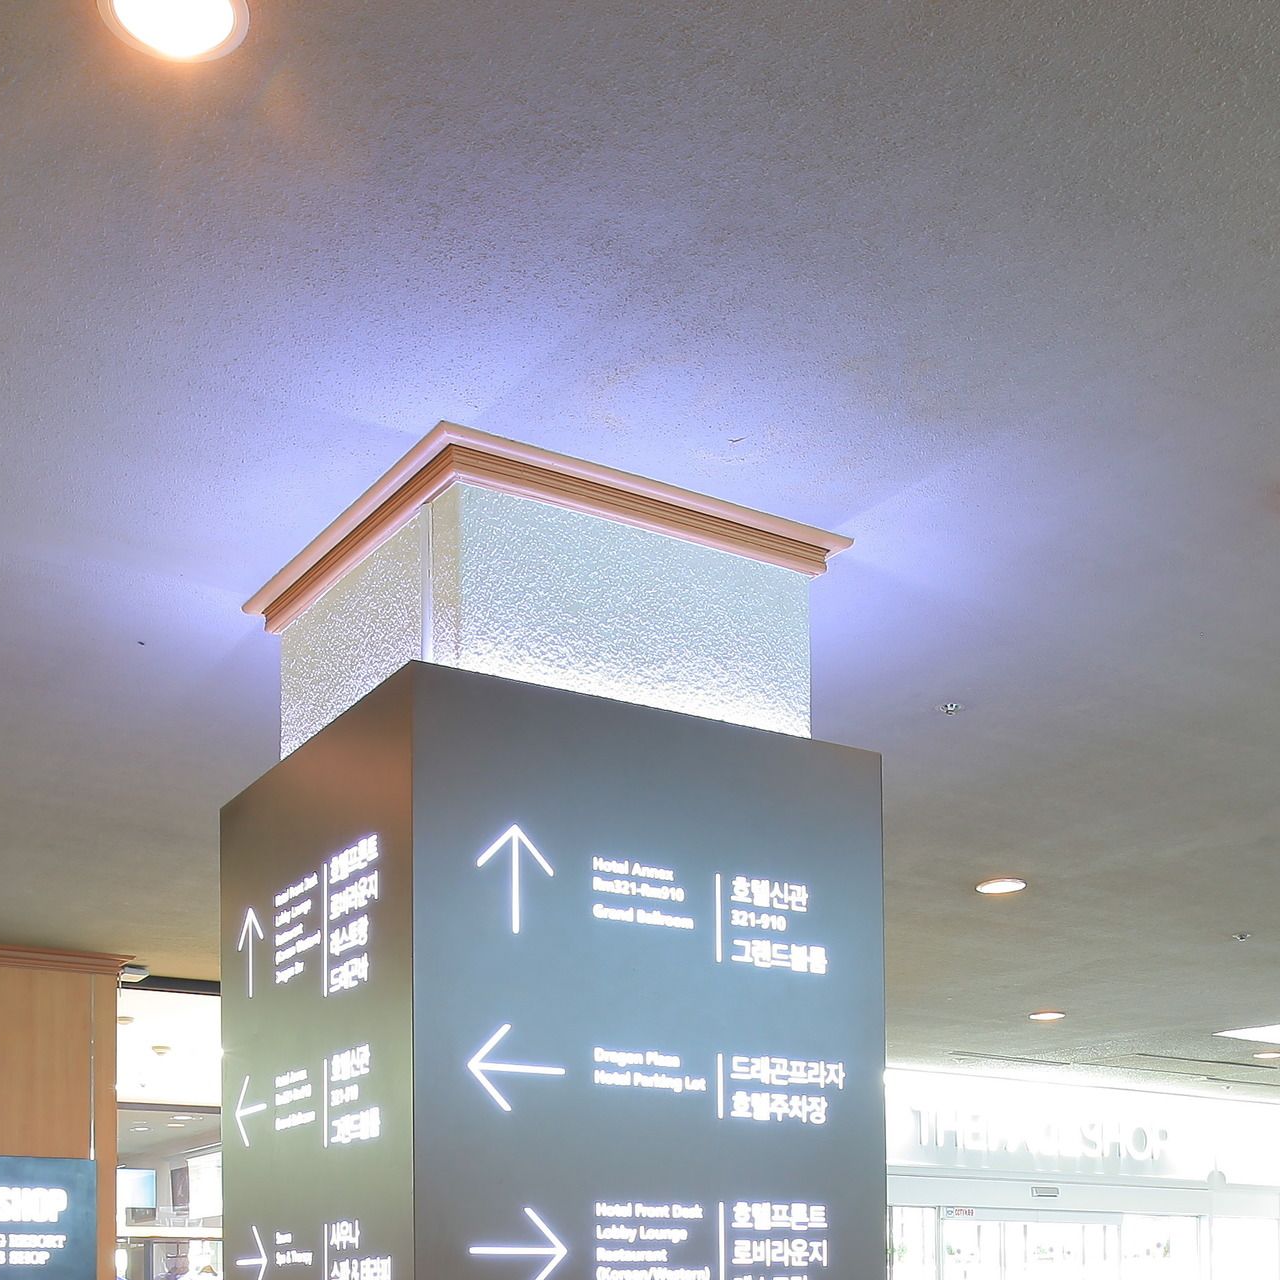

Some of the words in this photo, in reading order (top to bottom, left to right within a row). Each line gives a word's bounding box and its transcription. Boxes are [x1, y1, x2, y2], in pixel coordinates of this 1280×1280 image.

[592, 856, 629, 875] Hotel
[730, 876, 808, 912] 호텔신관
[730, 909, 787, 931] 321-910
[730, 1055, 845, 1089] 드래곤프라자
[730, 1091, 827, 1124] 호텔주차장
[595, 1202, 632, 1218] Hotel
[731, 1202, 828, 1231] 호텔프론트
[596, 1224, 637, 1243] Lobby
[639, 1225, 688, 1244] Lounge
[731, 1238, 828, 1267] 로비라운지
